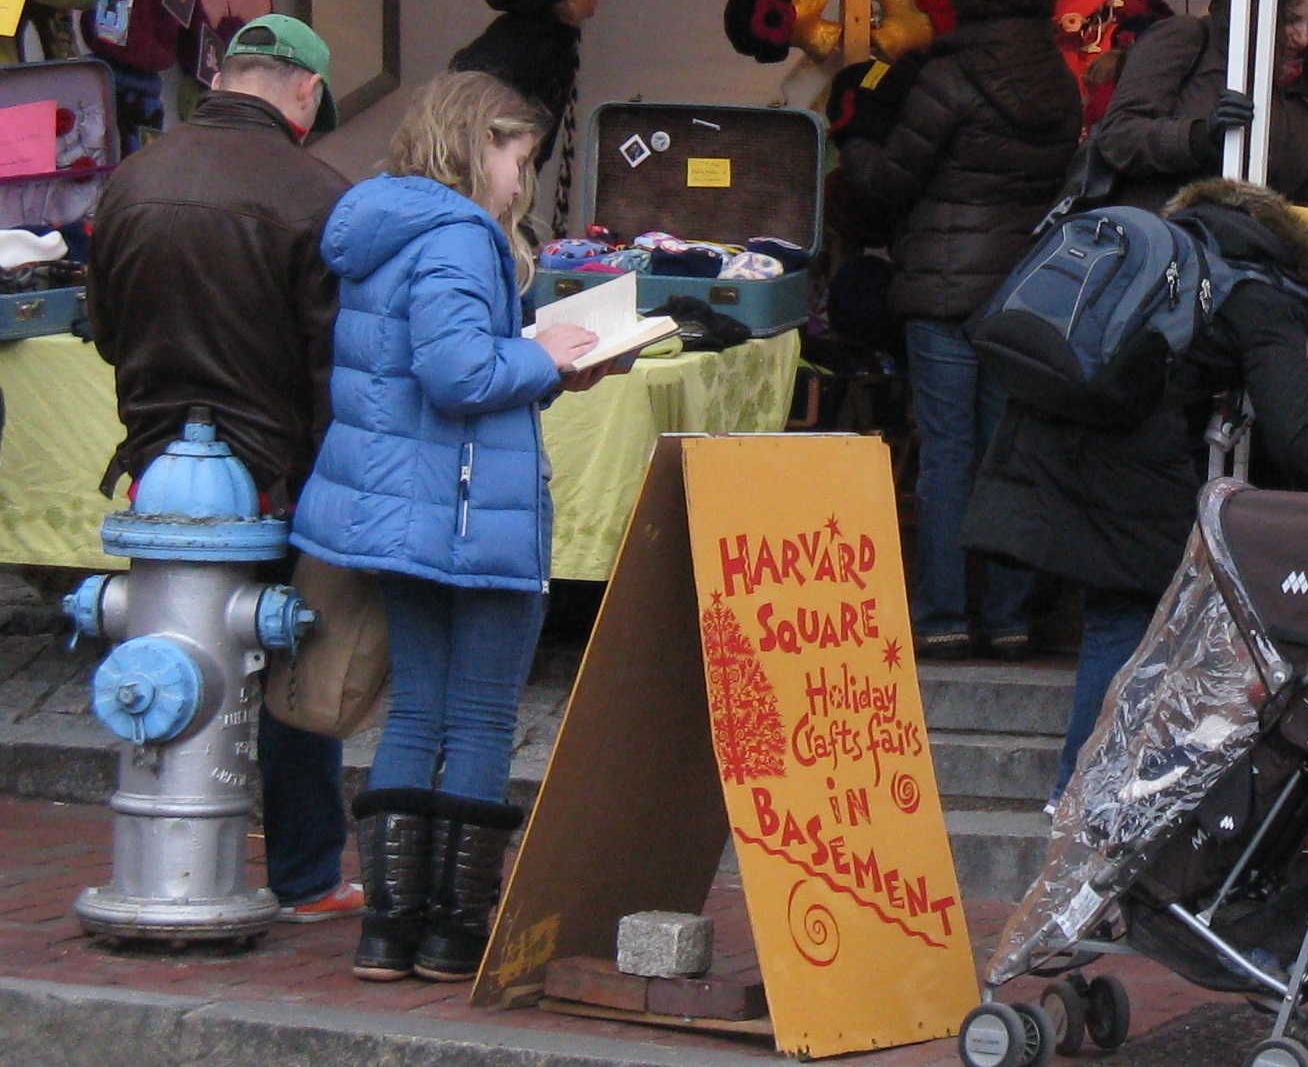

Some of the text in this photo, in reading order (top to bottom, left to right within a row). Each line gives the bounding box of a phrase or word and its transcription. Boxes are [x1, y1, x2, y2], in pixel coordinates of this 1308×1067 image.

[718, 531, 876, 597] HARVARD
[756, 598, 879, 654] SQUARE
[805, 663, 898, 723] Holiday
[791, 712, 863, 770] Crafts
[751, 787, 956, 936] BASEMENT
